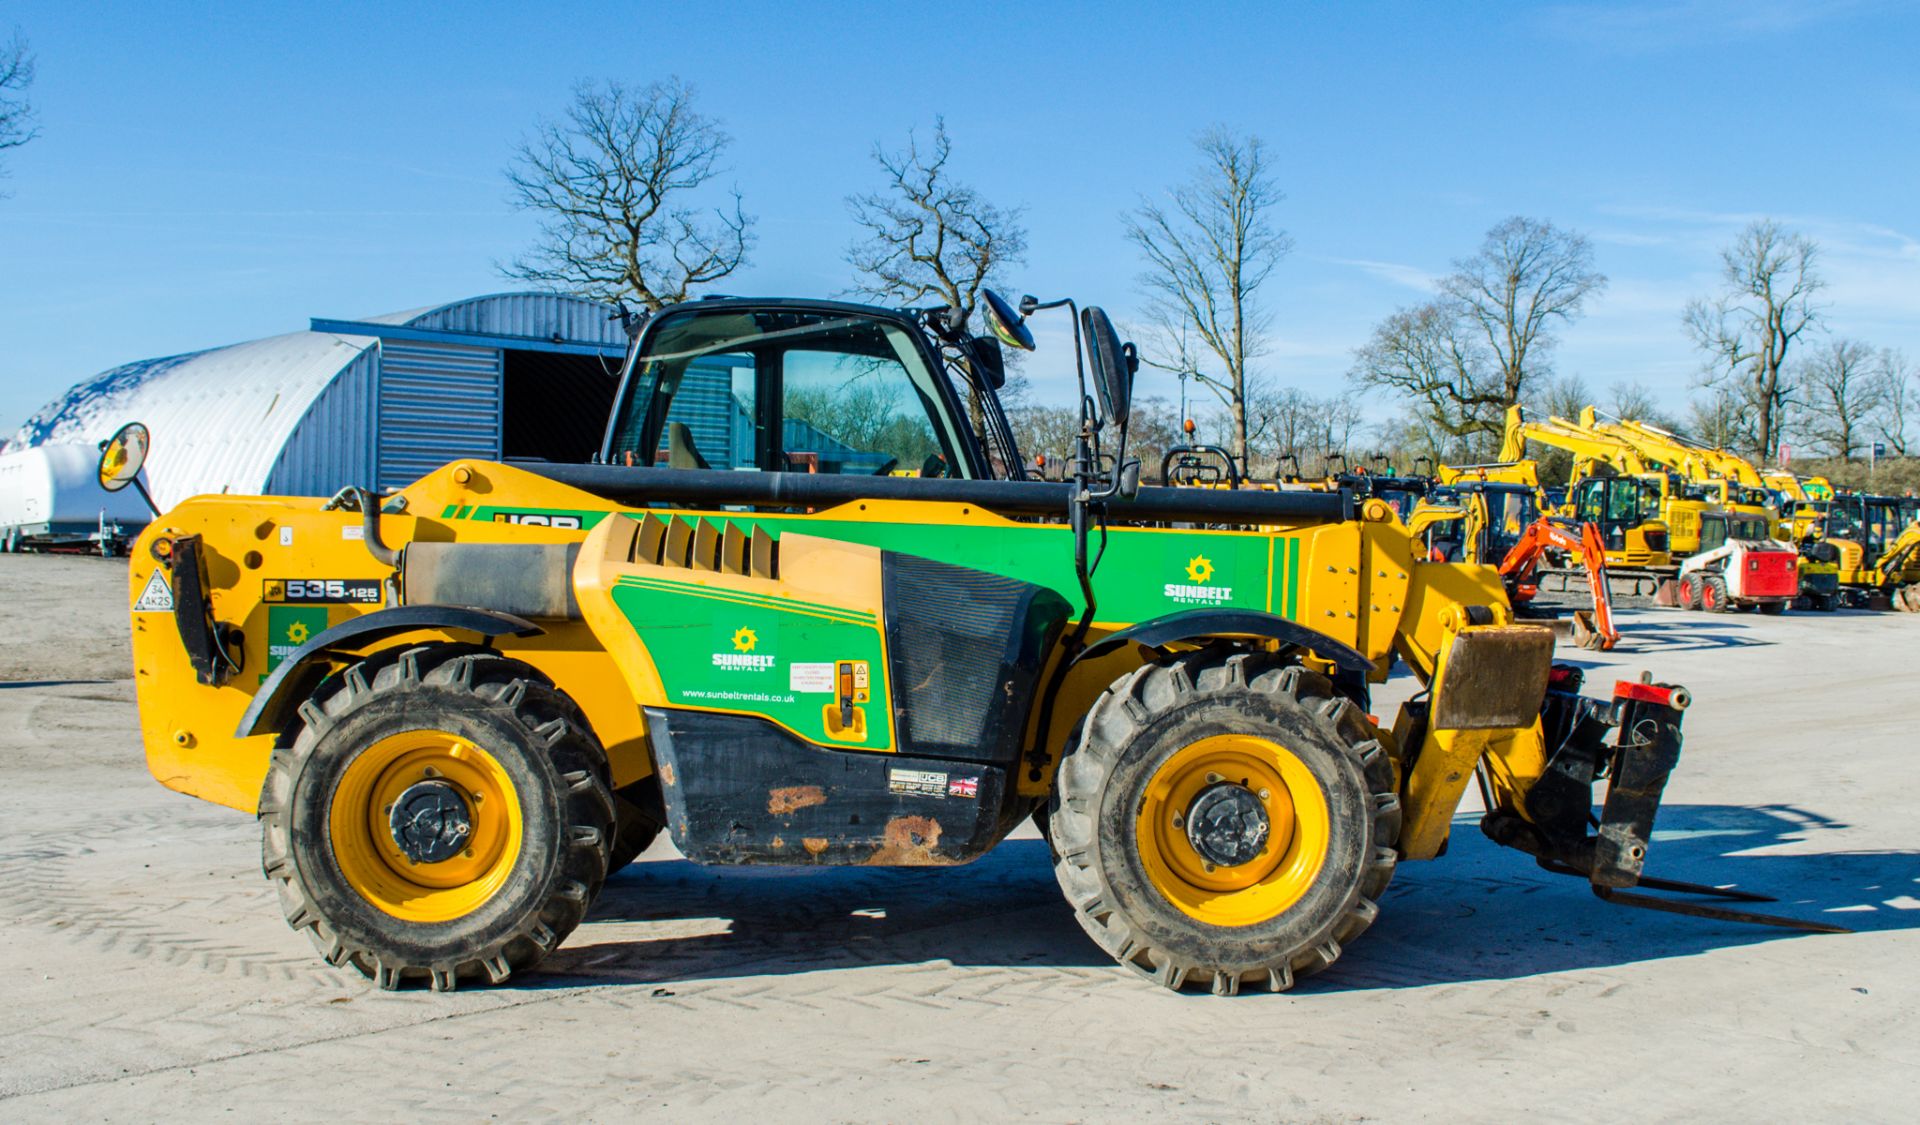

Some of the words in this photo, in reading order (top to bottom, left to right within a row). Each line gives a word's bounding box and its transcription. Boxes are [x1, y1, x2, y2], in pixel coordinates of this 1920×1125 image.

[151, 585, 164, 594] 34
[1164, 583, 1232, 600] SUNBELT
[1173, 597, 1222, 605] RENTALS
[712, 653, 775, 667] SUNBELT
[682, 690, 795, 703] www.sunbeltrentals.co.uk
[920, 773, 945, 782] JCB
